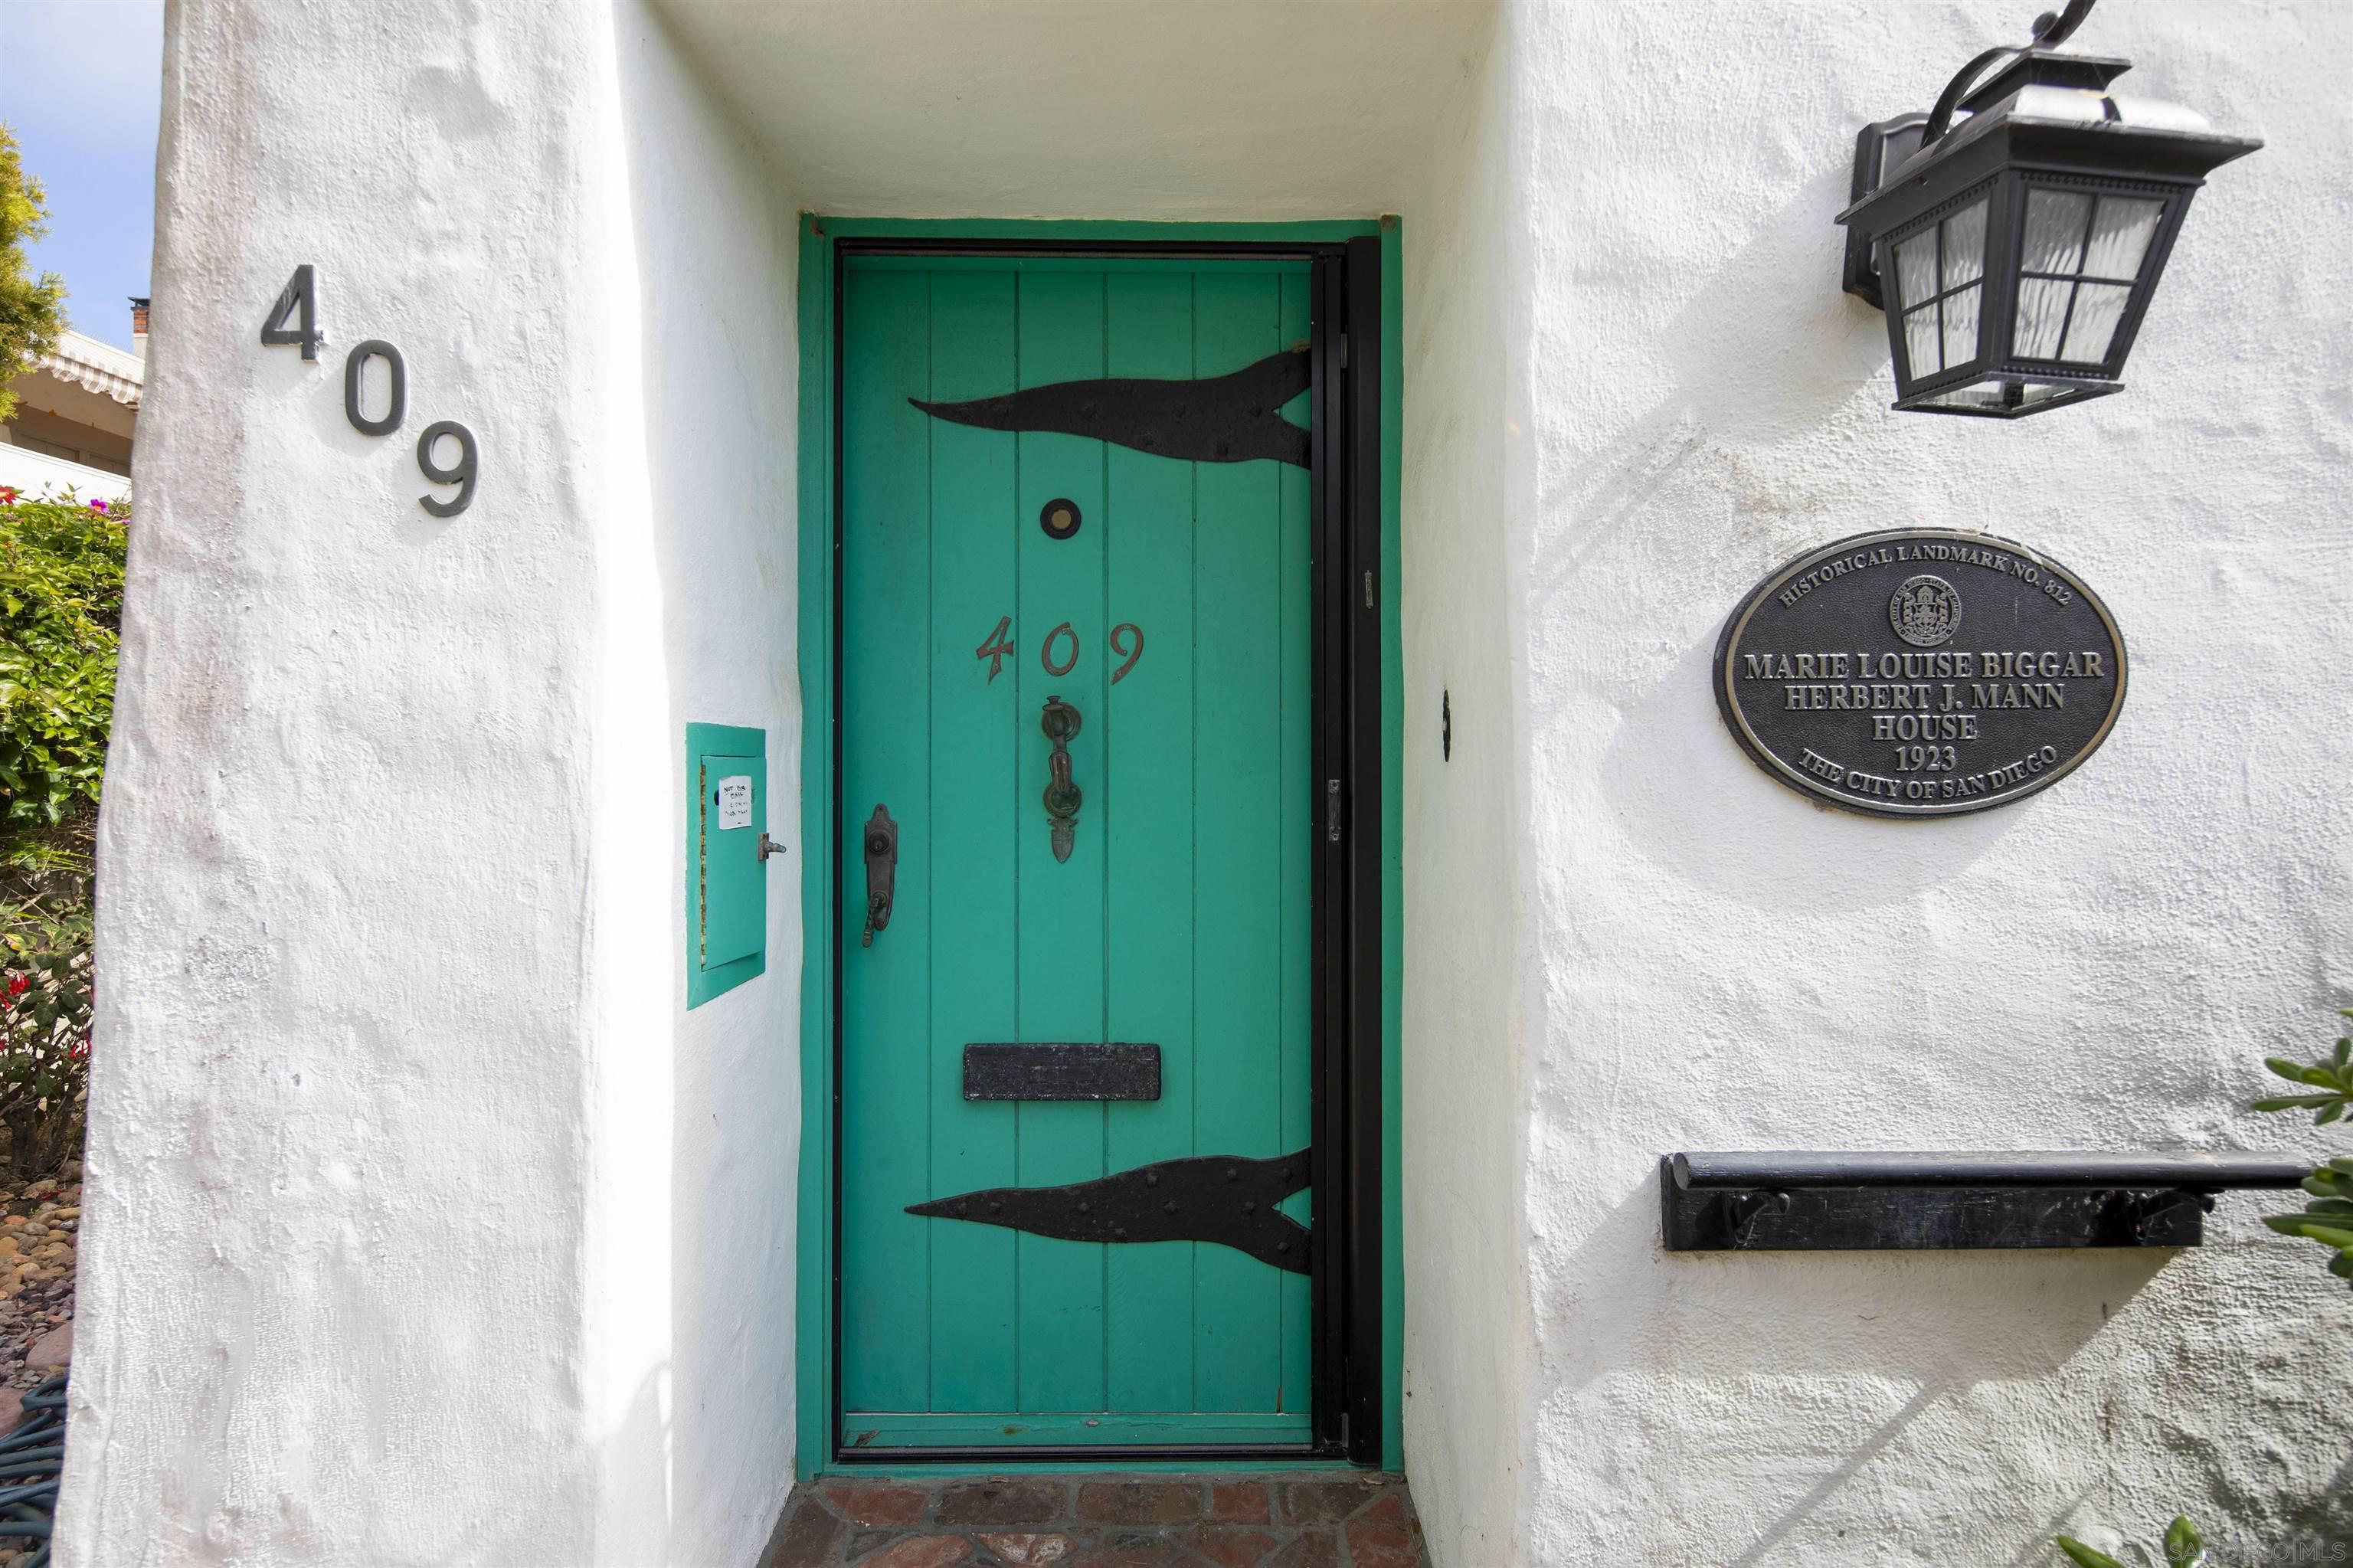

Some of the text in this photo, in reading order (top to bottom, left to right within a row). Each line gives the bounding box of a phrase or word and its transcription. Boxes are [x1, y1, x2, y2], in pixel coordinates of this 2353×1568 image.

[260, 264, 479, 518] 409
[1779, 545, 2072, 608] HISTORICAL LANDMARK NO. 812
[976, 615, 1144, 686] 409
[1744, 652, 2105, 679] MARIE LOUISE BIGGAR
[1785, 683, 2065, 712] HERBERT J. MANN
[1872, 714, 1978, 741] HOUSE
[1798, 745, 2057, 800] THE CITY OF SAN DIEGO
[1895, 745, 1956, 771] 1923
